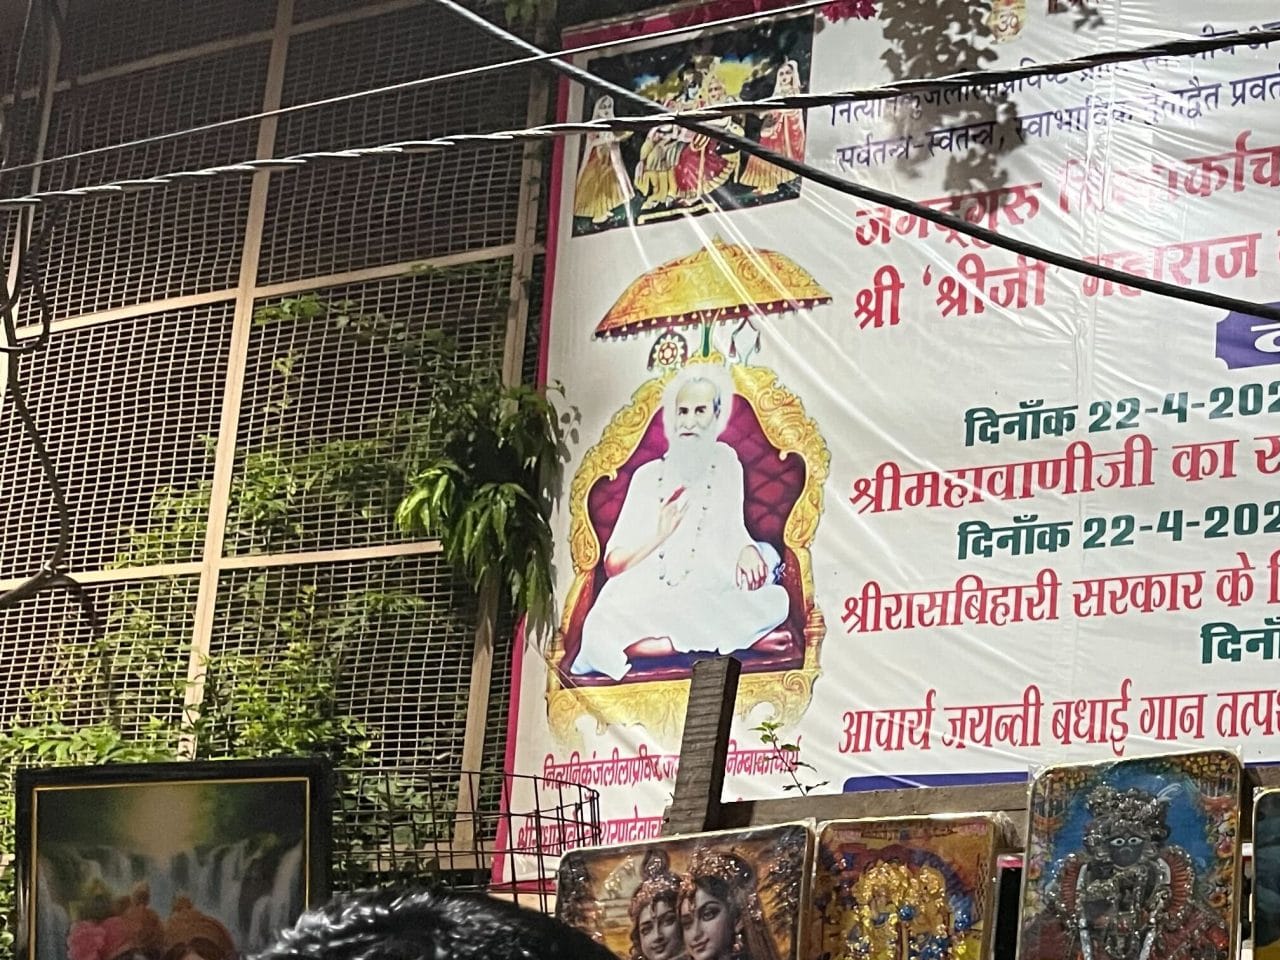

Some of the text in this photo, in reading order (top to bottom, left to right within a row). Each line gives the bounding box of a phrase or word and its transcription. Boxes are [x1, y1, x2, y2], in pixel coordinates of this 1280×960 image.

[854, 265, 905, 330] श्री
[849, 434, 1158, 514] श्रीमहावाणीजी
[1171, 438, 1239, 483] का
[841, 568, 1062, 634] श्रीरासबिहारी
[1072, 570, 1206, 618] सरकार
[1215, 551, 1256, 607] के
[838, 688, 936, 753] आचार्य
[942, 684, 1044, 748] जयन्ती
[1051, 678, 1132, 756] बधाई
[1139, 693, 1208, 741] गान
